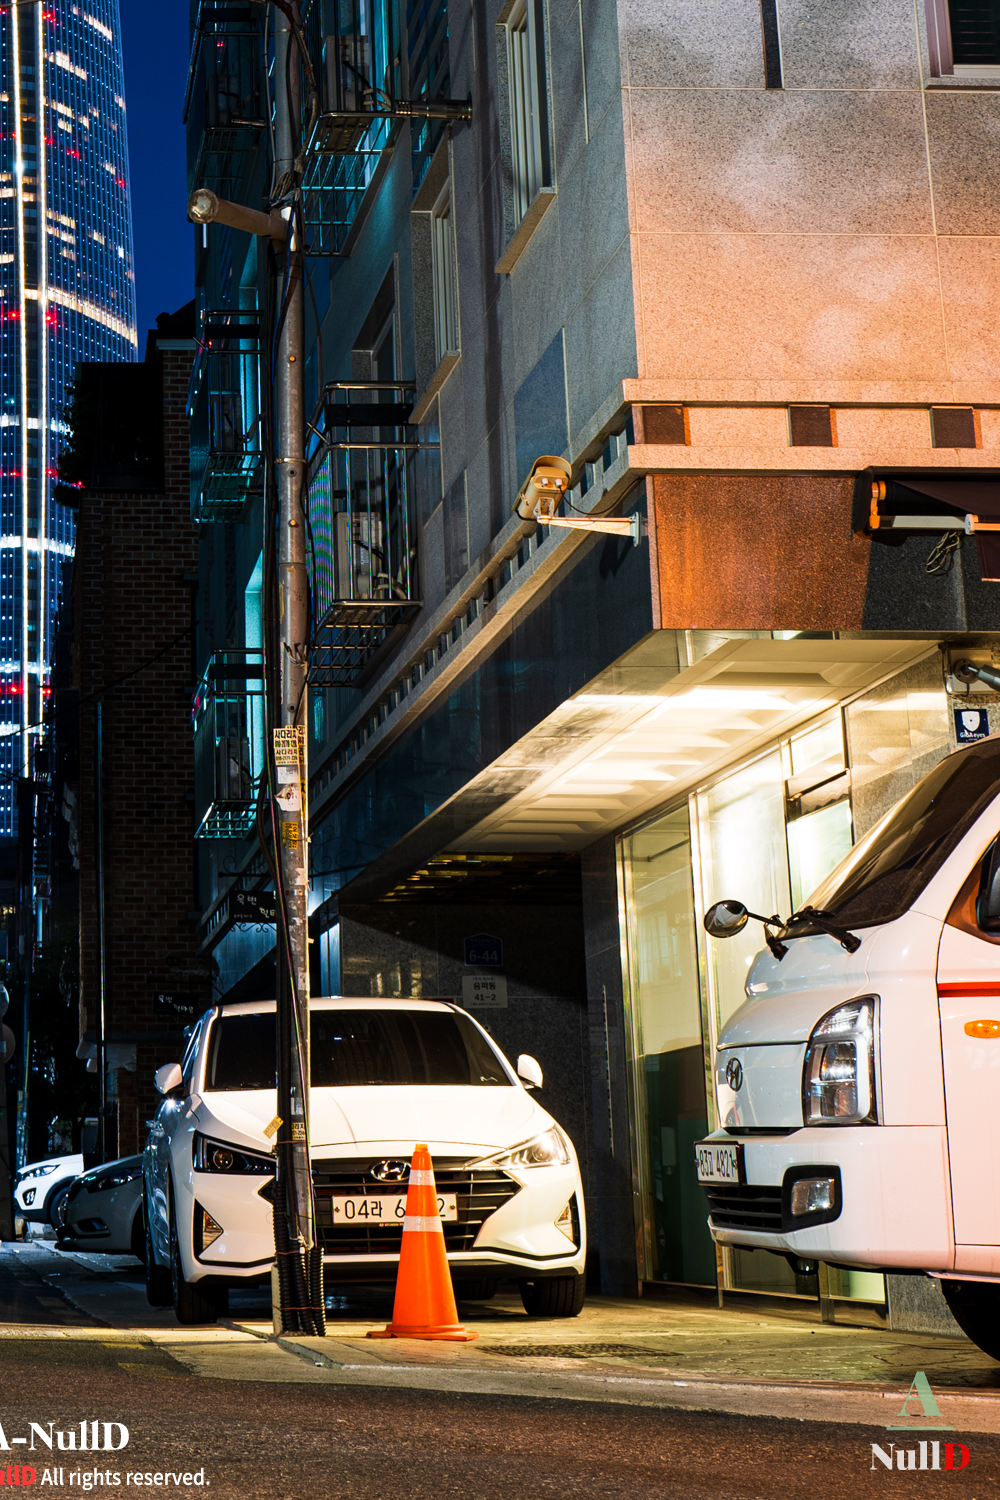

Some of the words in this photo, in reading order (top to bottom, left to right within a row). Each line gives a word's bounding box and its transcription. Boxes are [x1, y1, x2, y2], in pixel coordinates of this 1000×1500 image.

[468, 949, 499, 962] 6-44
[474, 993, 497, 1001] 41-2
[344, 1199, 383, 1219] 04라
